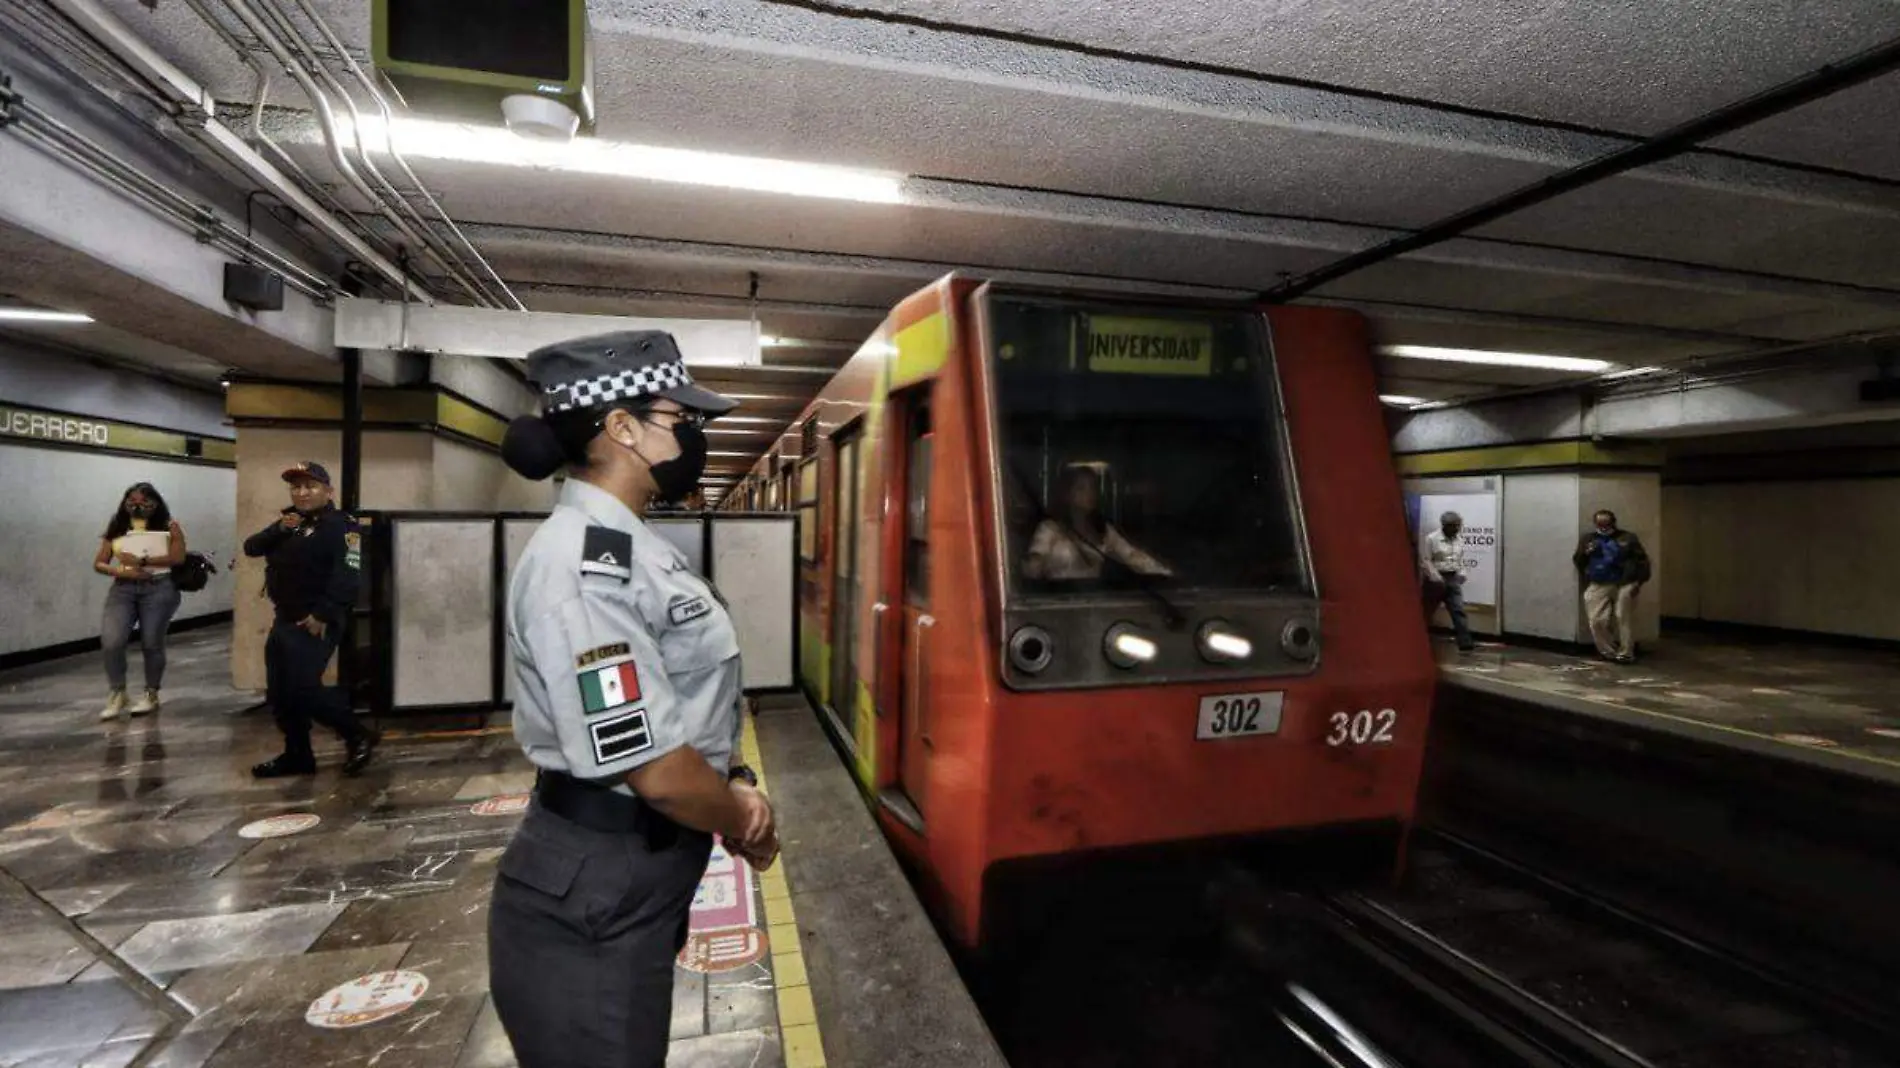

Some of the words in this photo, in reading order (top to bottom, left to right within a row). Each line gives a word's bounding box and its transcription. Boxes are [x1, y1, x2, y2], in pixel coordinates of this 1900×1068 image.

[1461, 535, 1494, 546] XICO
[1211, 697, 1261, 734] 302
[1326, 708, 1397, 747] 302
